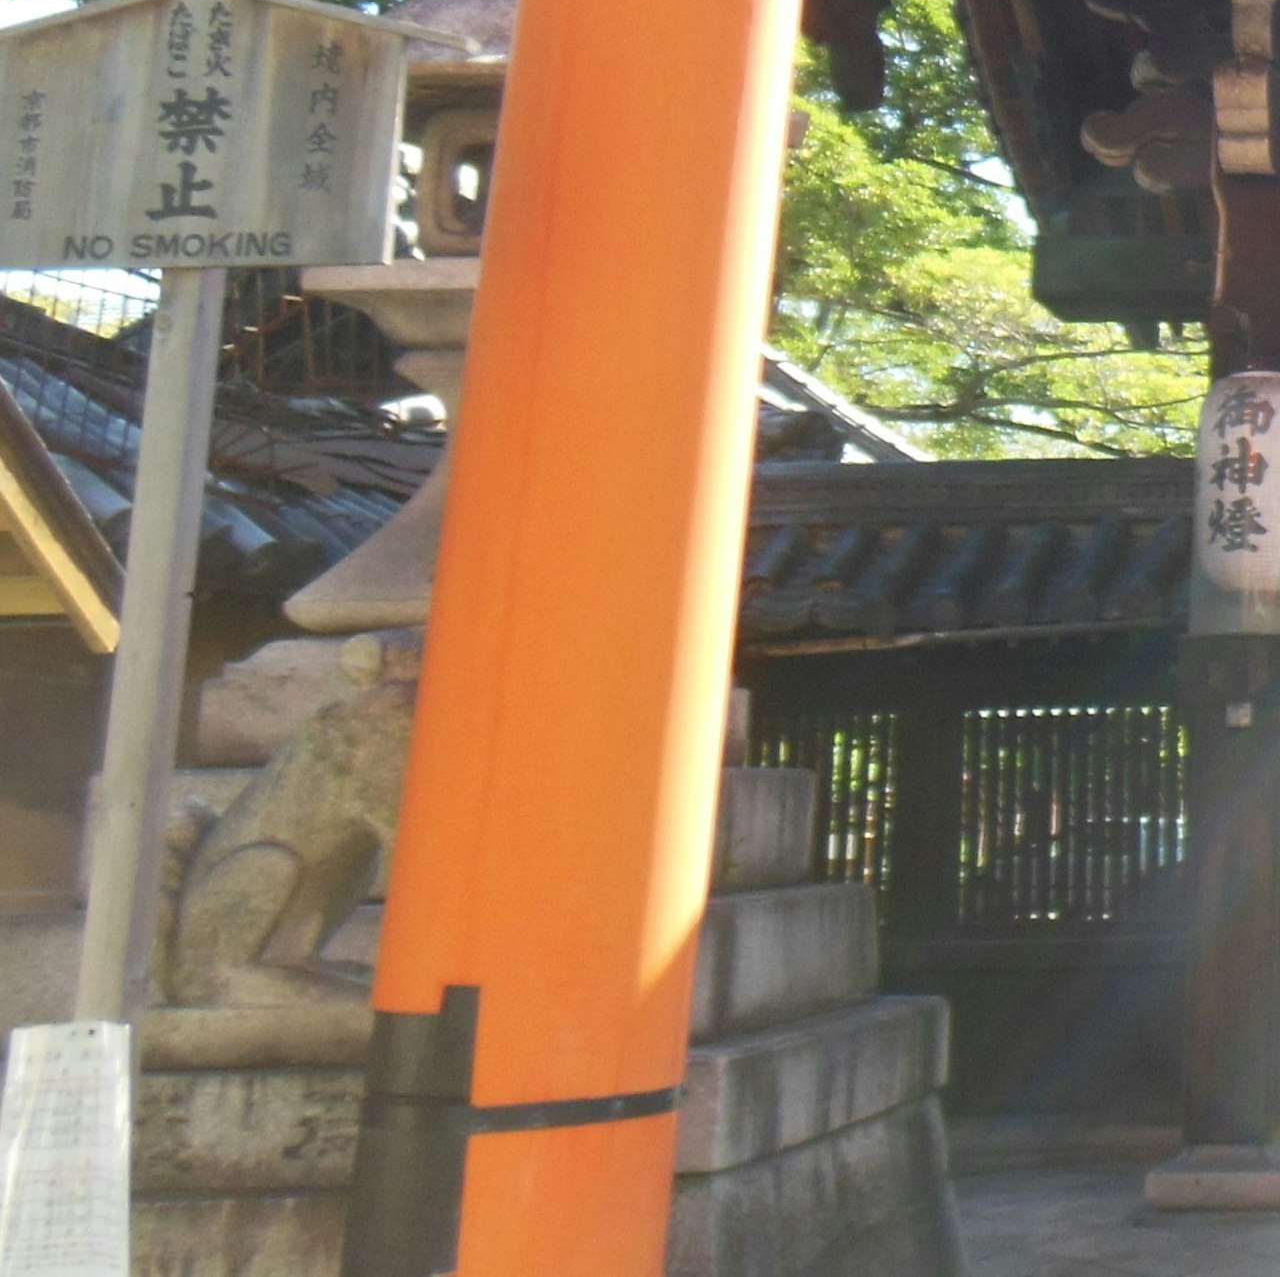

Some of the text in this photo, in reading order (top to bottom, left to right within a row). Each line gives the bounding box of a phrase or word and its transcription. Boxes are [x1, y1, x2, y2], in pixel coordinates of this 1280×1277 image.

[167, 1, 196, 78] たばこ
[203, 1, 234, 77] たき火
[146, 86, 235, 222] 禁止
[63, 231, 293, 260] NO SMOKING
